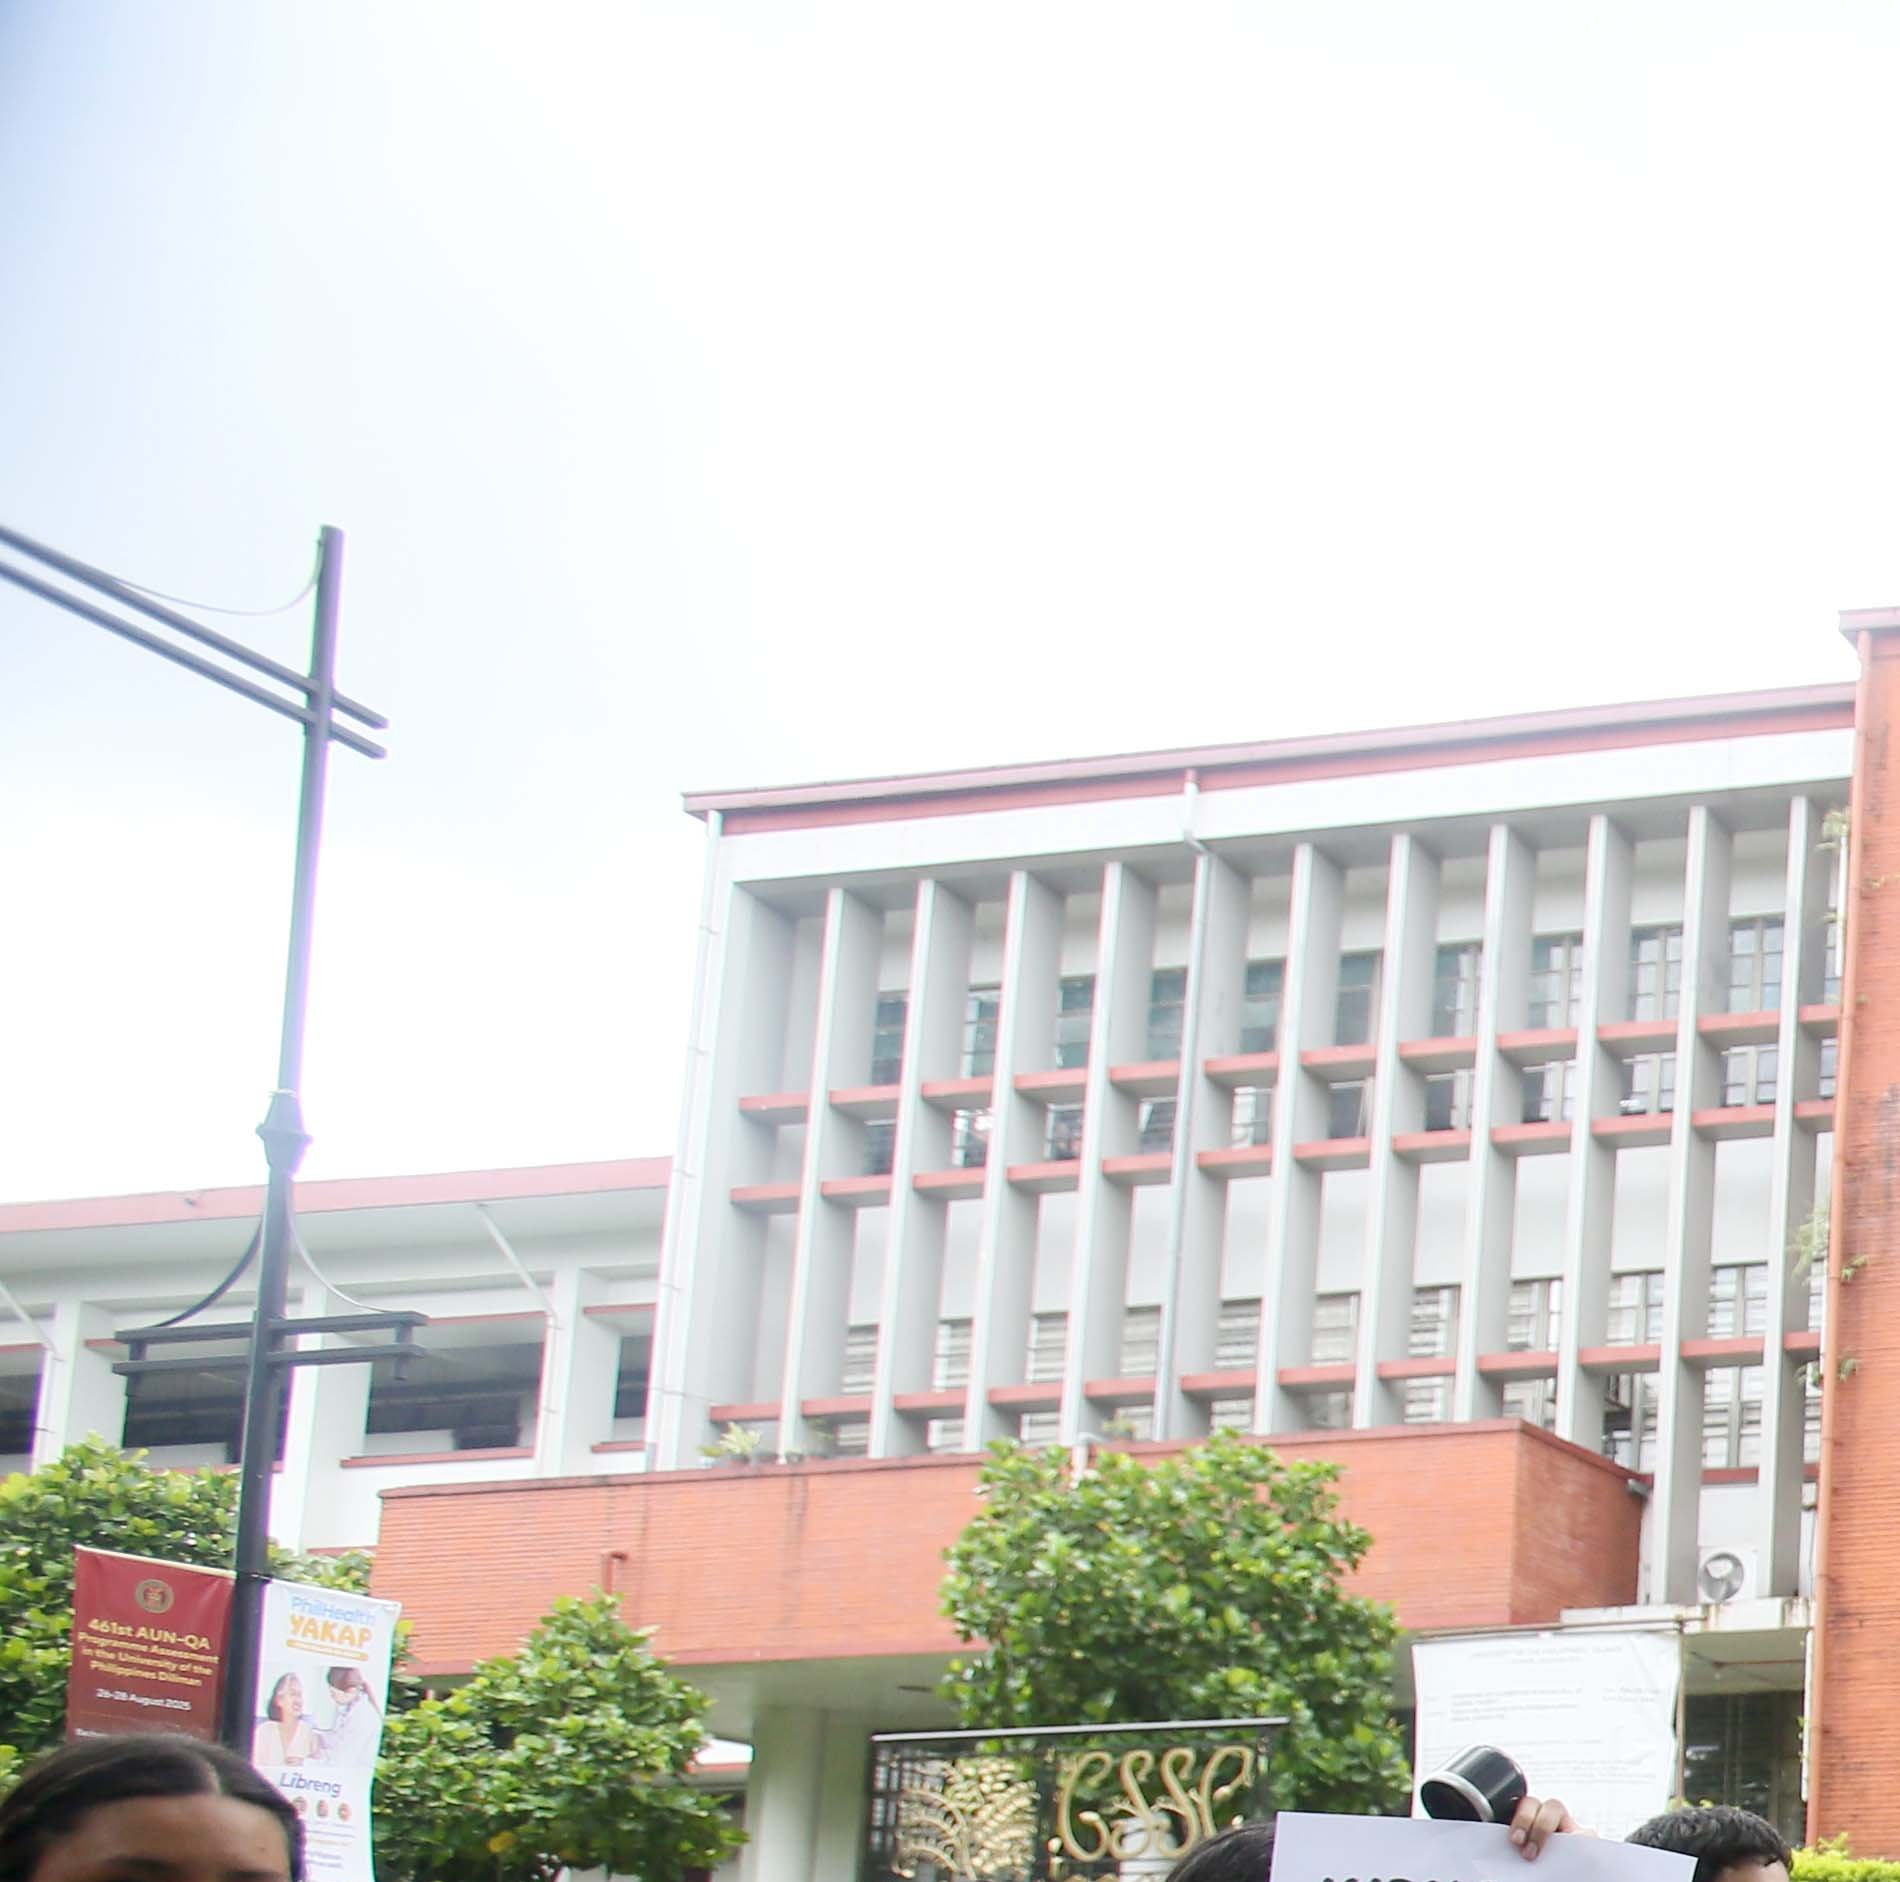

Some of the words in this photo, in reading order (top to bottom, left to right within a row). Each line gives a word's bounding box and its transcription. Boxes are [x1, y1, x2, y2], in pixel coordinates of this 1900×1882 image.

[291, 1596, 375, 1625] PhilHealth
[88, 1618, 134, 1638] 461st
[135, 1626, 211, 1650] AUN-QA
[290, 1614, 373, 1649] YAKAP
[78, 1631, 149, 1653] Programme
[151, 1644, 220, 1664] Assessment
[95, 1649, 116, 1660] the
[117, 1651, 178, 1671] University
[90, 1660, 157, 1680] Philippines
[157, 1671, 203, 1687] Diliman
[129, 1693, 165, 1707] August
[280, 1772, 343, 1798] Libreng
